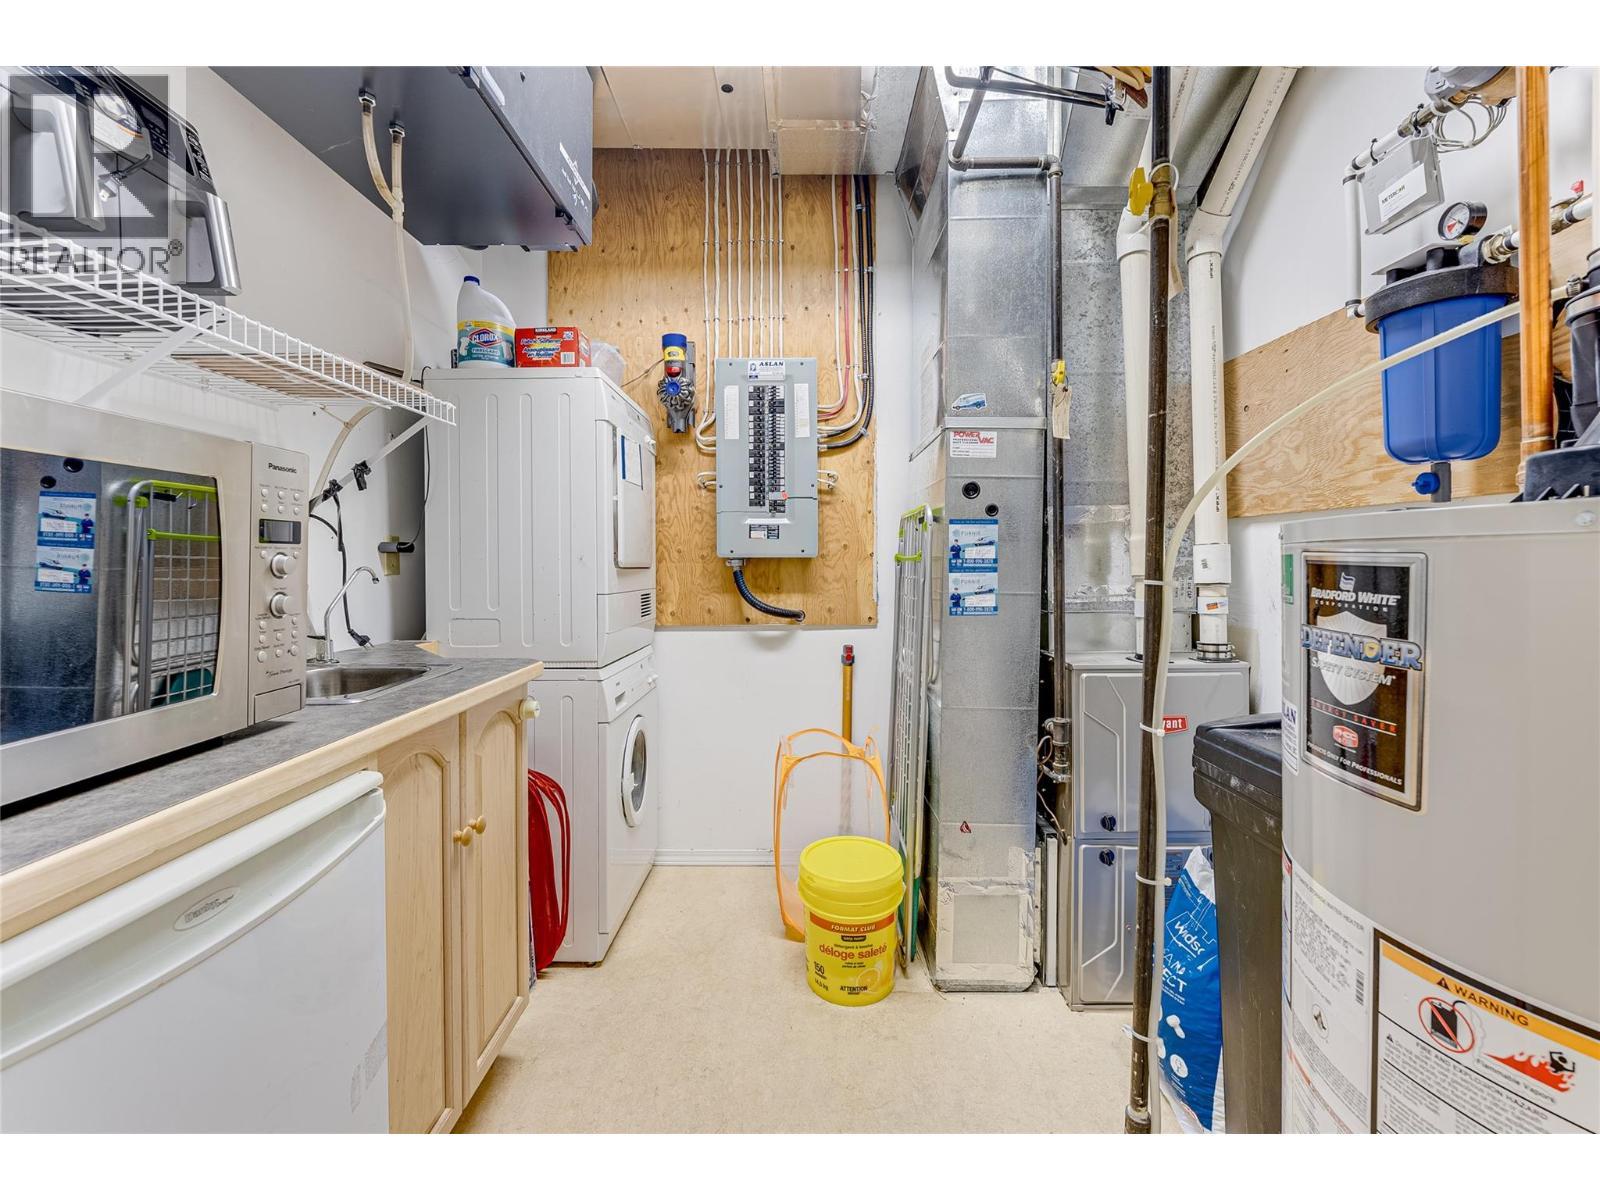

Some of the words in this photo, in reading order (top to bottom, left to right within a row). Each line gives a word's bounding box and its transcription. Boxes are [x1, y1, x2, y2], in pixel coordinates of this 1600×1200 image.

[472, 333, 498, 342] CLOROX
[978, 436, 995, 444] VAC
[268, 462, 297, 474] Panasonic
[1311, 587, 1357, 603] BRADFORD
[1357, 591, 1401, 606] WHITE
[1315, 600, 1388, 612] CORPORATION
[1301, 624, 1424, 672] DEFENDER
[1311, 656, 1343, 674] SAFETY
[1352, 714, 1398, 733] SAVER
[1340, 756, 1351, 766] FOR
[1352, 761, 1402, 785] PROFESSIONALS
[831, 924, 858, 932] FORMAT
[860, 923, 877, 932] CLUB
[818, 943, 855, 961] déloge
[857, 942, 888, 959] saleté
[1454, 983, 1529, 1026] WARNING
[1415, 1041, 1433, 1055] FIRE
[1435, 1053, 1453, 1067] AND
[1452, 1064, 1503, 1097] EXPLOSION
[1506, 1095, 1549, 1119] HAZARD
